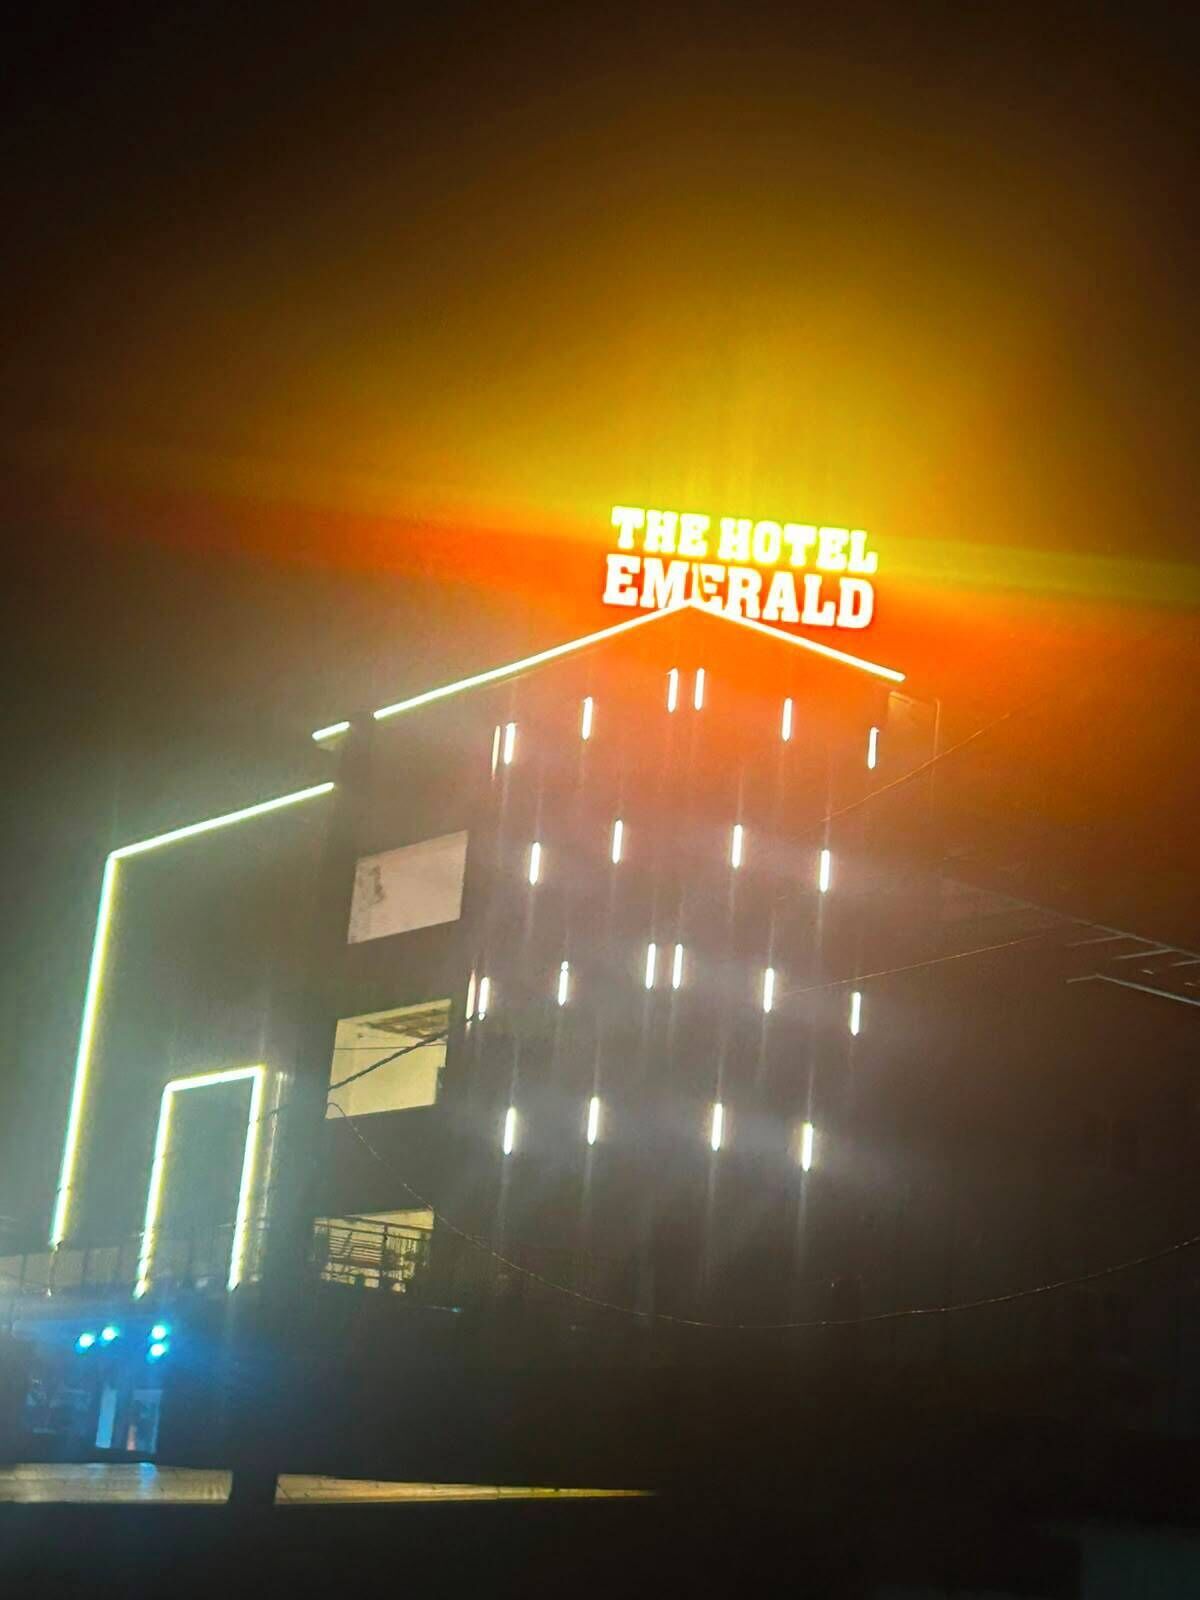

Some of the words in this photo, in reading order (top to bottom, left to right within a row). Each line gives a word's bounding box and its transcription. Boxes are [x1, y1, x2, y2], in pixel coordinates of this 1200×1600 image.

[611, 505, 710, 557] THE
[717, 516, 878, 575] HOTEL
[602, 553, 875, 629] EMERALD
